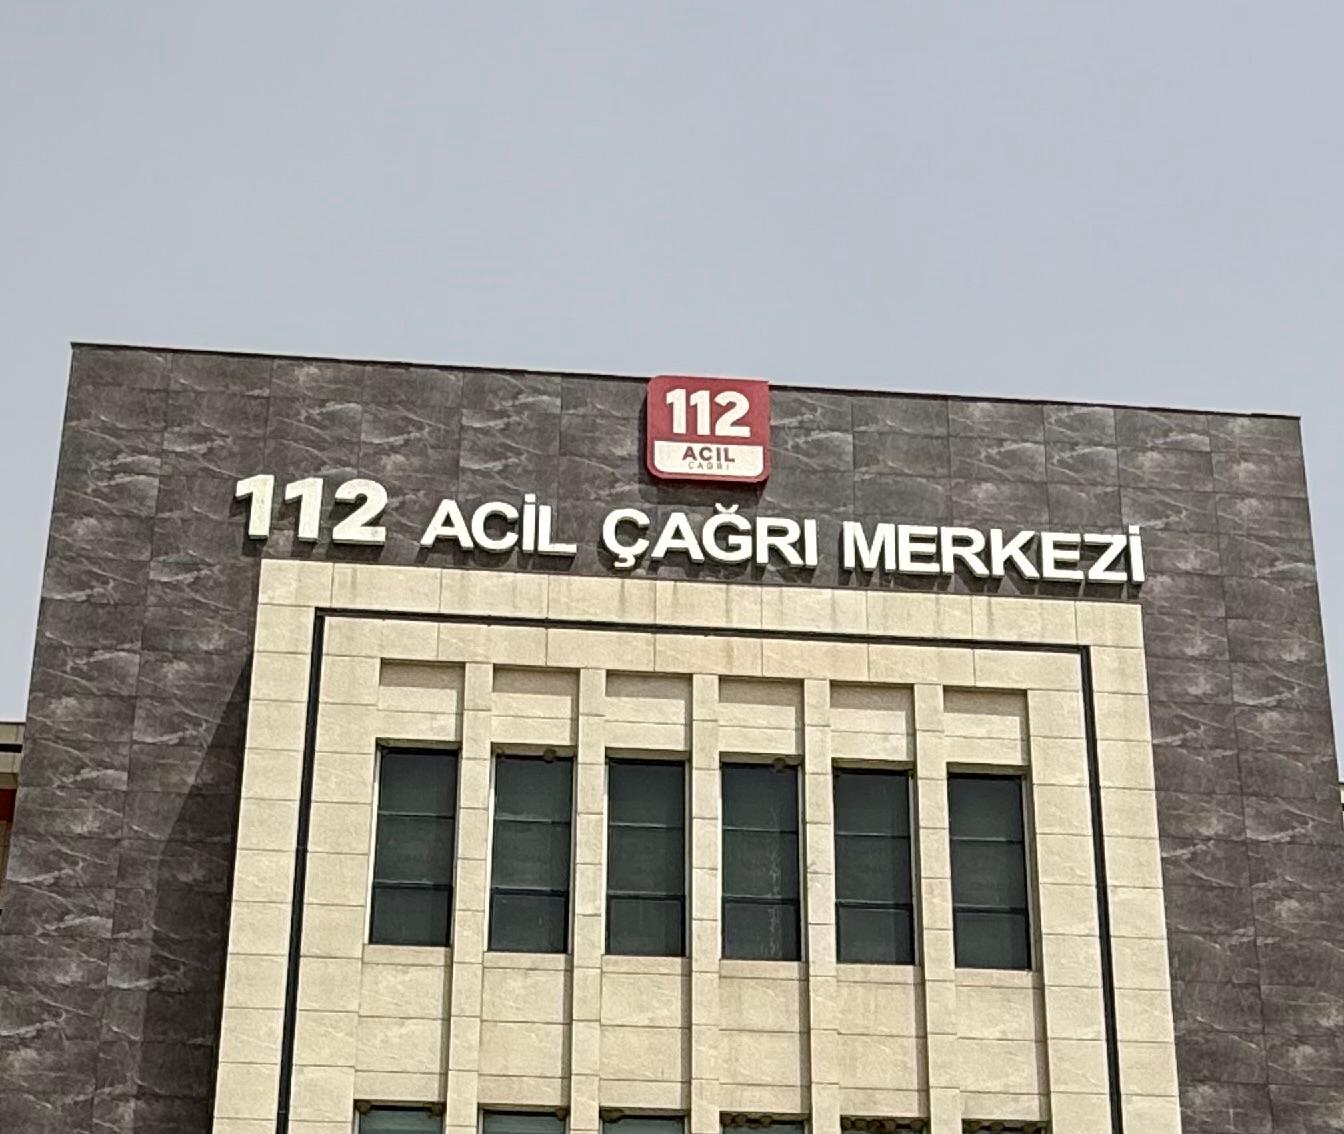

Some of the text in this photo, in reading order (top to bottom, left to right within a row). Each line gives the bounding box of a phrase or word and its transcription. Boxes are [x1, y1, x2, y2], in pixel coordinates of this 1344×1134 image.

[665, 388, 751, 438] 112
[234, 474, 1146, 584] 112 ACİL ÇAĞRI MERKEZİ
